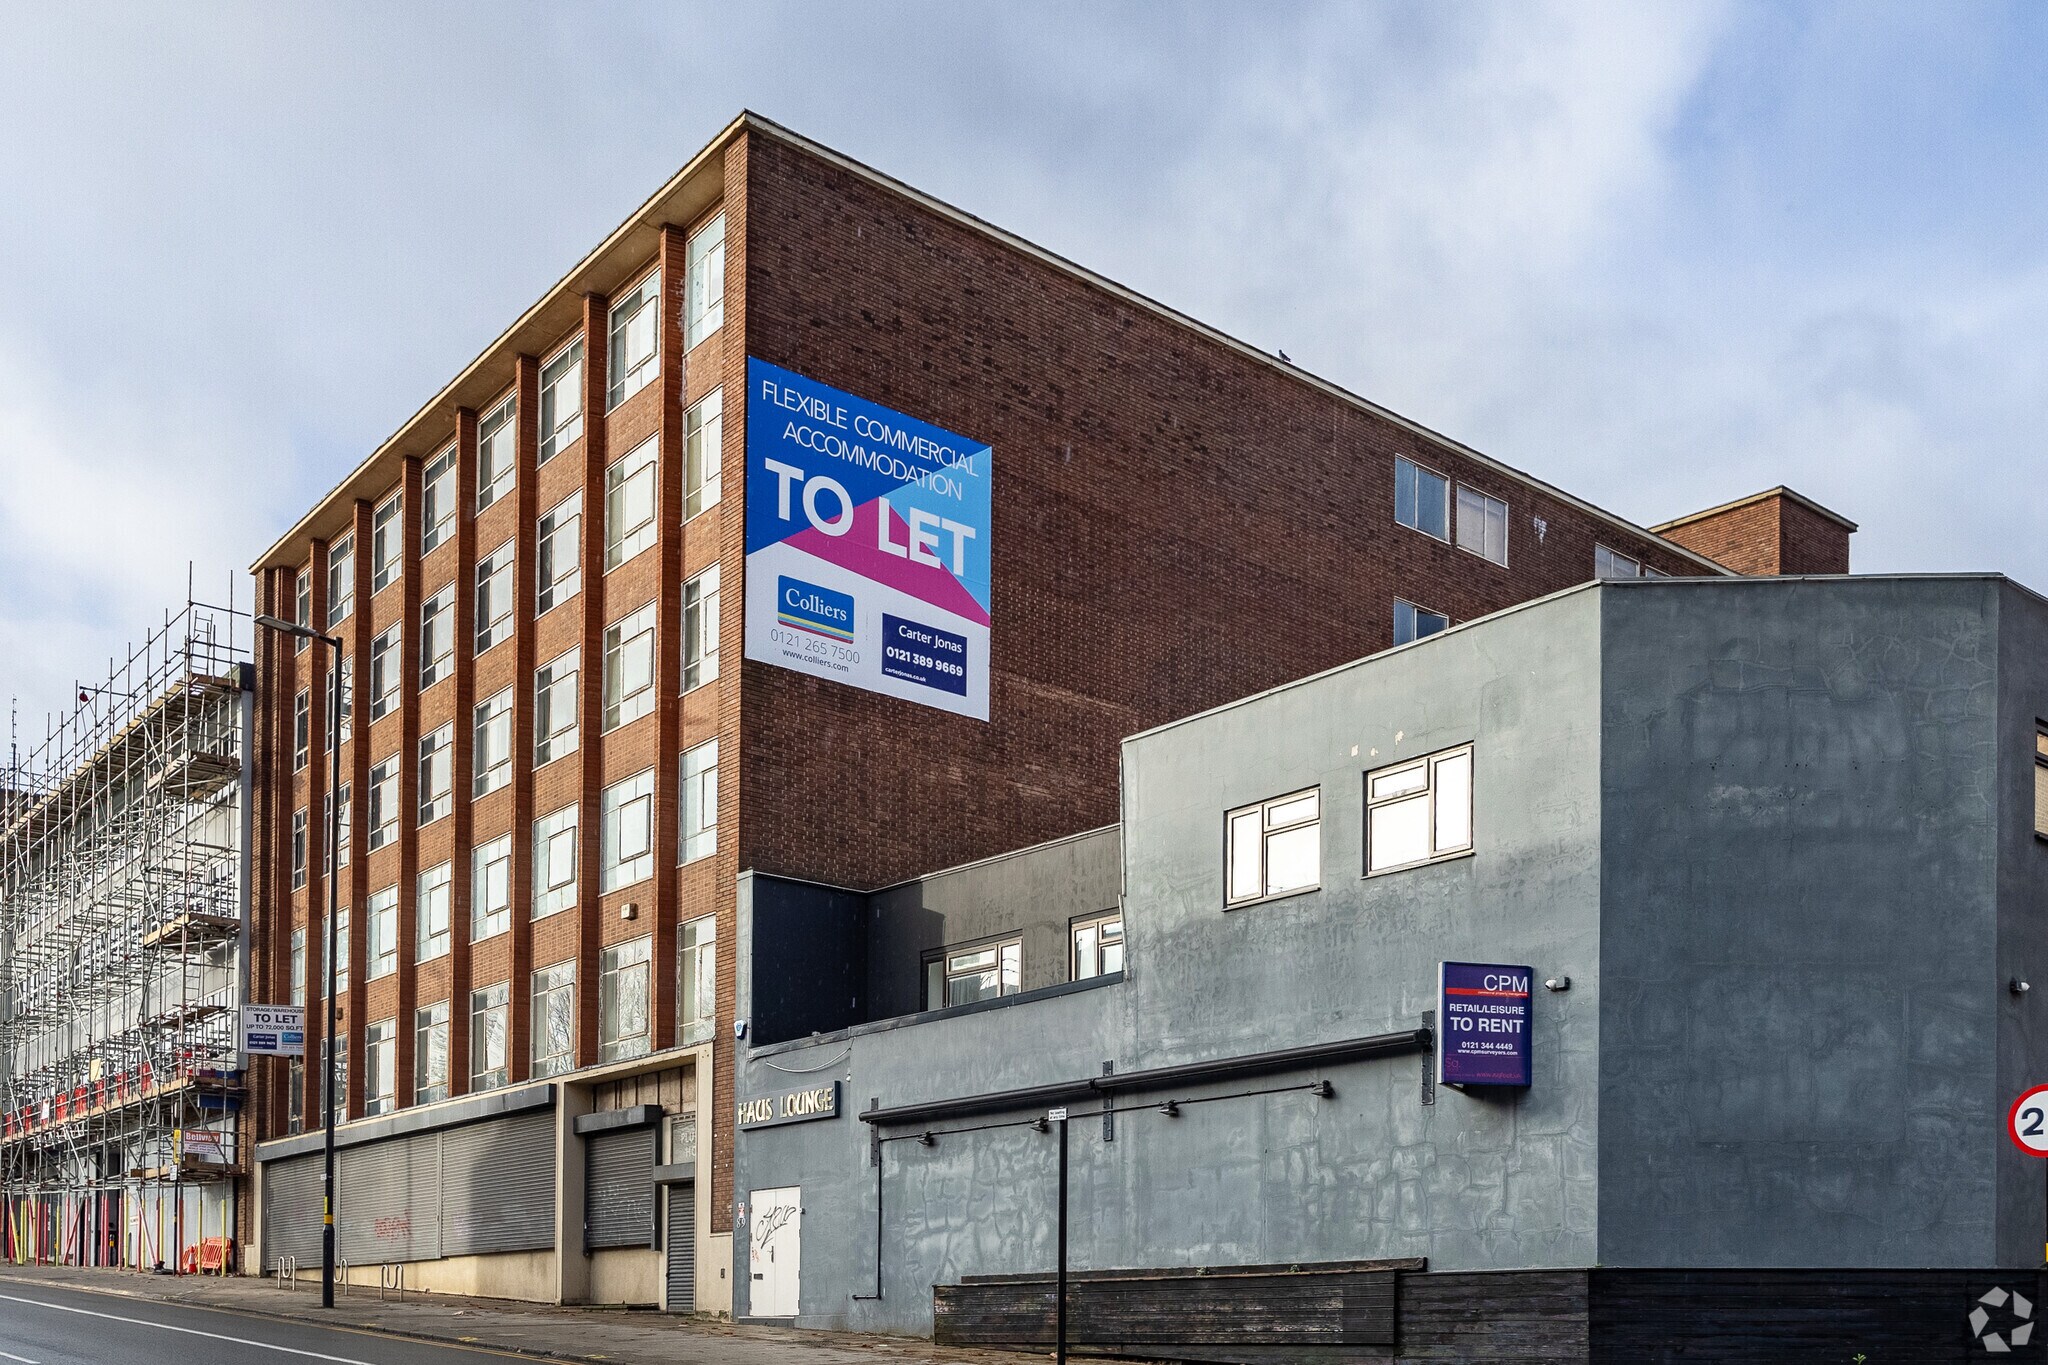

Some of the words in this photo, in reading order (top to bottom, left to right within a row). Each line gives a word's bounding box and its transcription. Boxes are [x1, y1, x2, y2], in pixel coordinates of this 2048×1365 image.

[763, 380, 848, 430] FLEXIBLE
[854, 415, 979, 478] COMMERCIAL
[782, 421, 962, 501] ACCOMMODATION
[765, 457, 854, 537] TO
[878, 496, 976, 577] LET
[785, 588, 847, 622] Colliers
[770, 629, 799, 647] 0121
[805, 638, 827, 655] 265
[831, 644, 860, 664] 7500
[898, 625, 932, 644] Carter
[934, 635, 962, 653] Jonas
[782, 649, 849, 673] www.colliers.com
[886, 646, 910, 662] 0121
[912, 653, 933, 668] 389
[935, 660, 963, 676] 9669
[1483, 974, 1528, 993] CPM
[254, 1013, 271, 1023] TO
[276, 1014, 298, 1024] LET
[1449, 1003, 1525, 1015] RETAIL/LEISURE
[1450, 1016, 1473, 1031] TO
[1478, 1018, 1524, 1033] RENT
[1461, 1041, 1479, 1049] 0121
[1495, 1042, 1513, 1050] 4449
[738, 1097, 773, 1124] HAUS
[780, 1087, 834, 1118] LOUNGE
